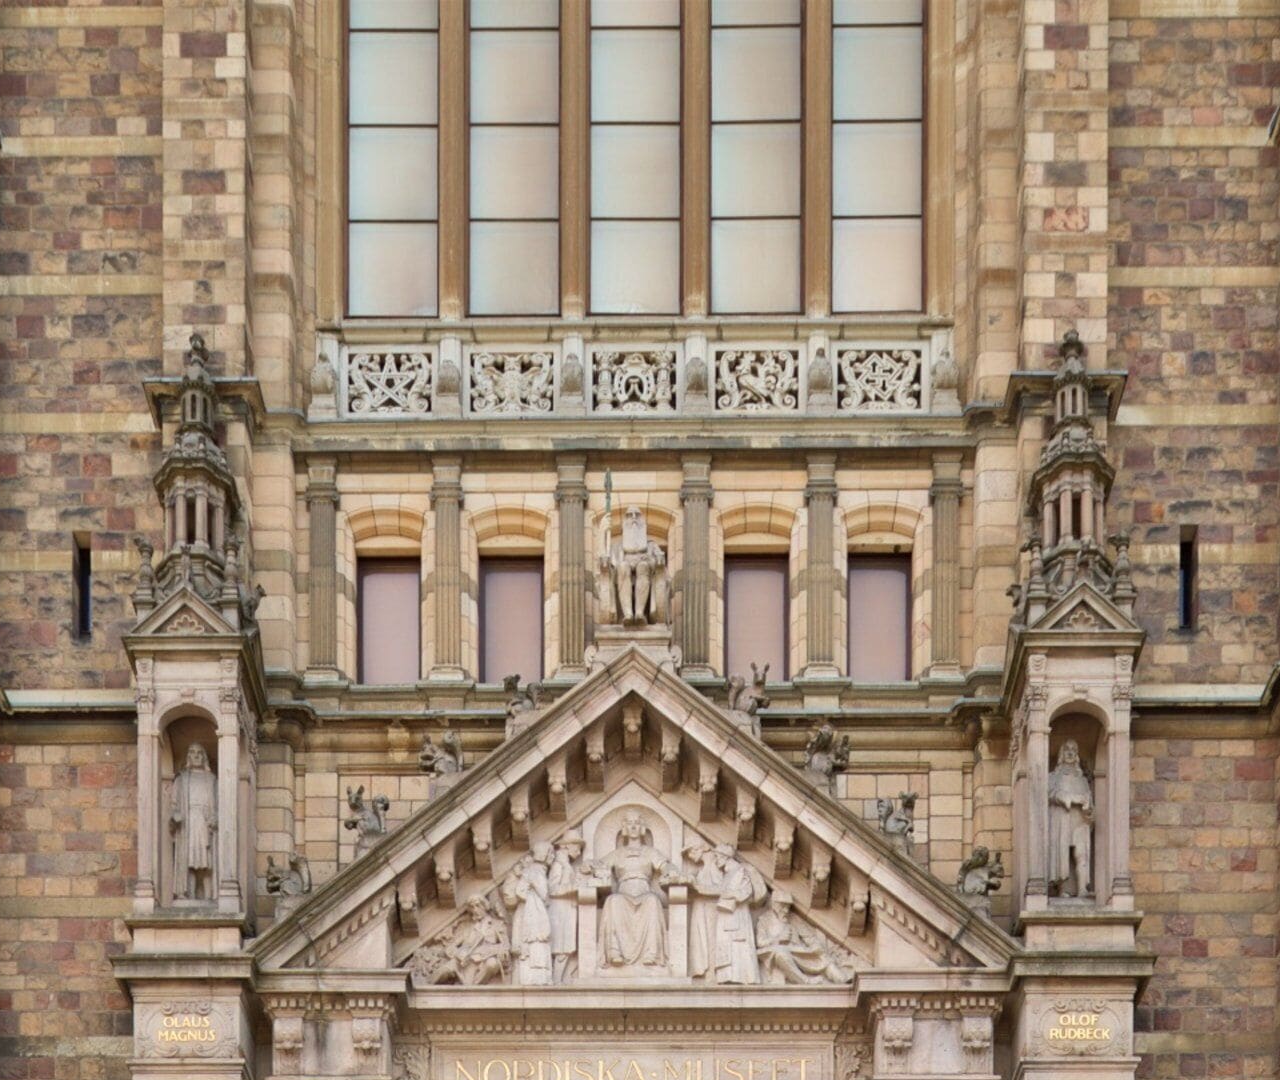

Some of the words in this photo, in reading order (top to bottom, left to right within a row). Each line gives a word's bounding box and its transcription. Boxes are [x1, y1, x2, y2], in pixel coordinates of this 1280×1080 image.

[163, 1015, 211, 1028] OLAUS
[1058, 1013, 1100, 1026] OLOF
[157, 1029, 217, 1042] MAGNUS
[1048, 1027, 1111, 1040] RUDBECK
